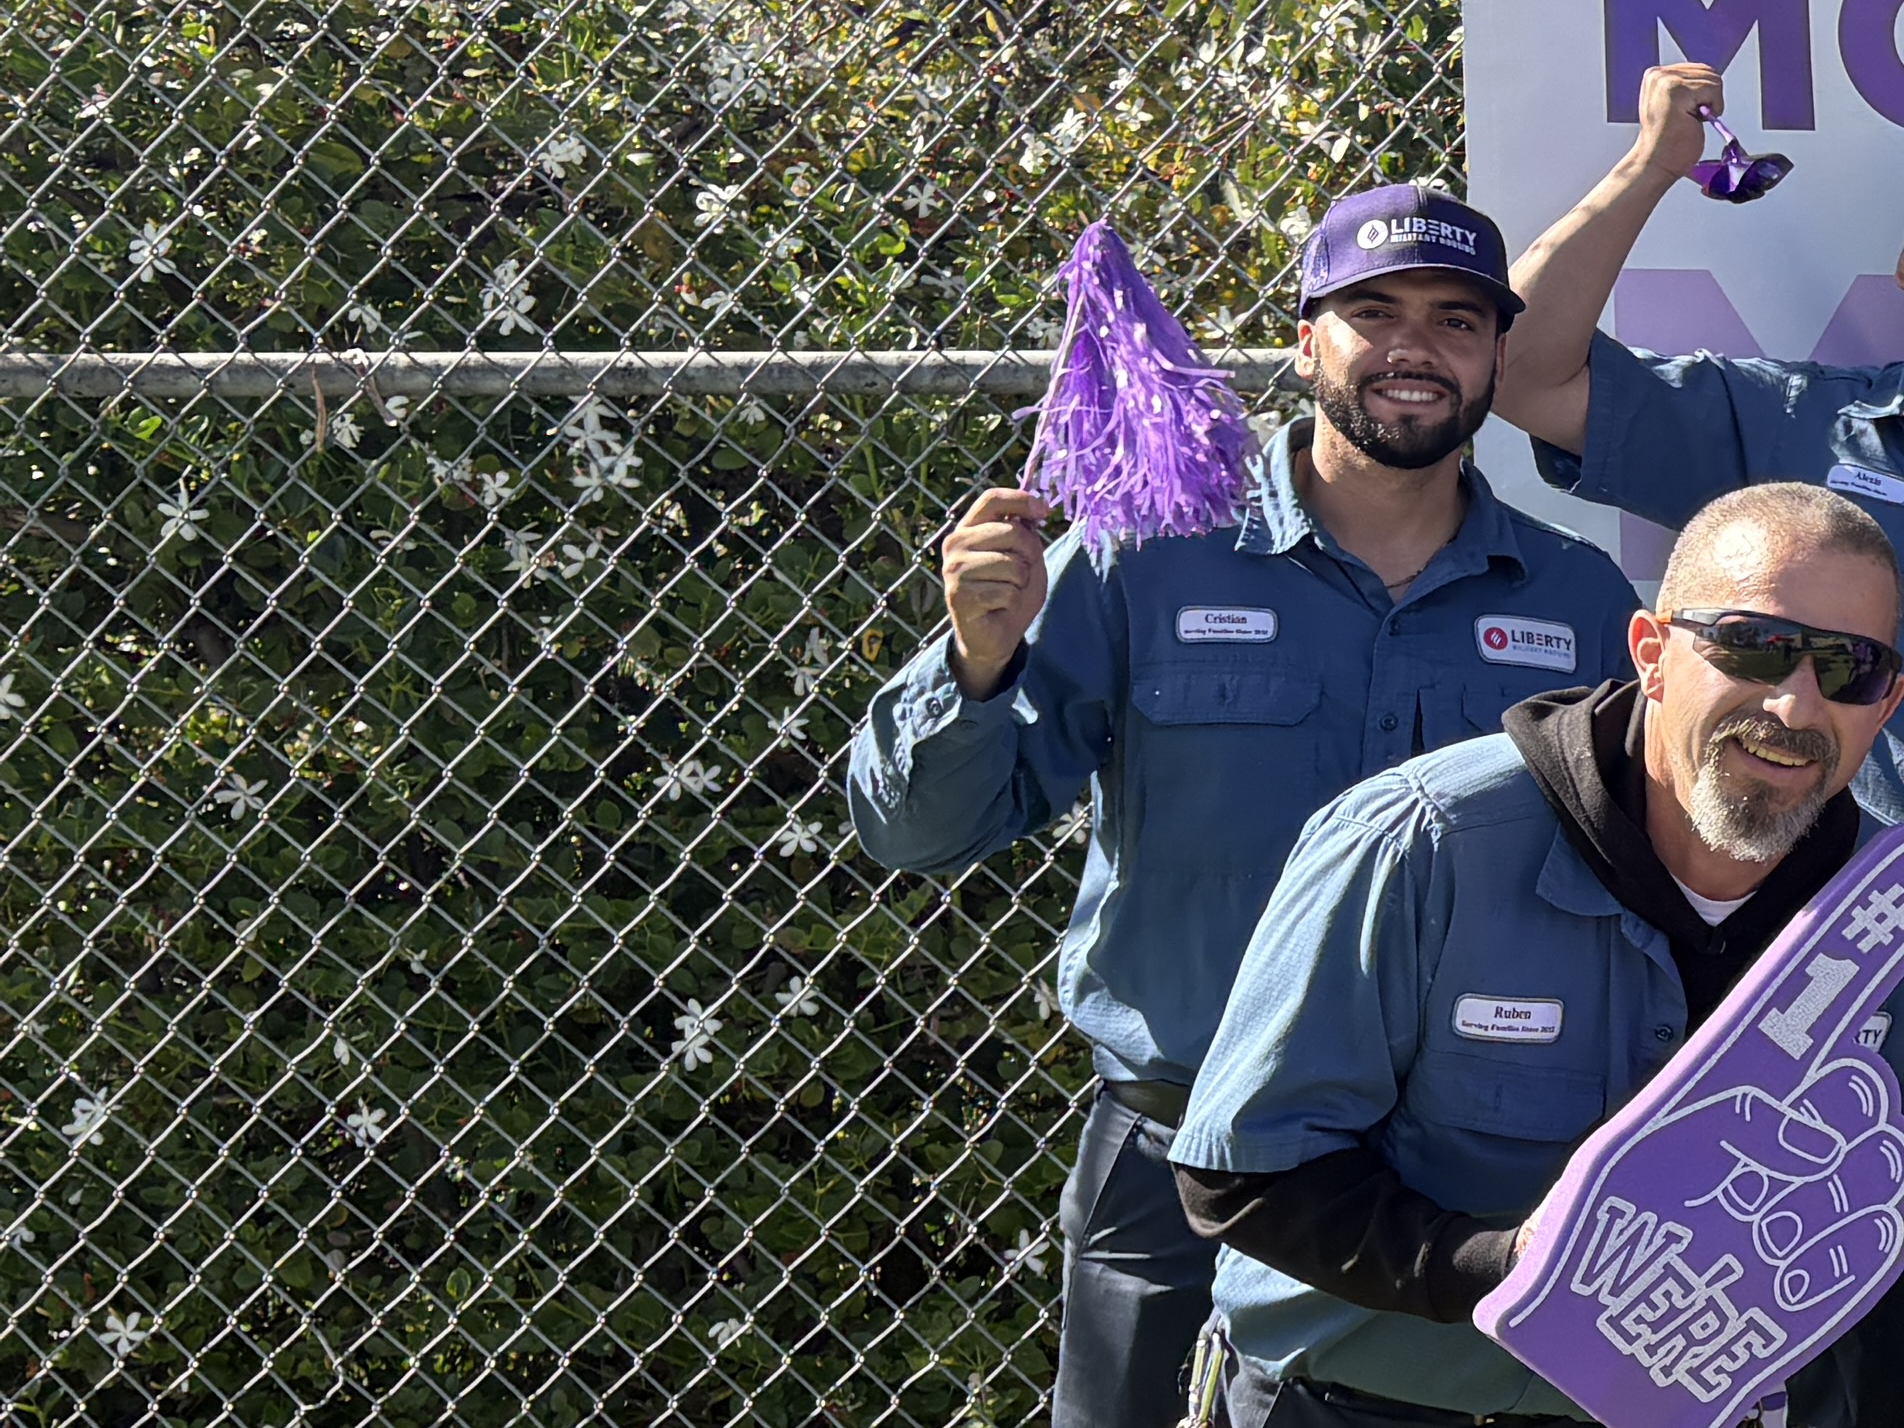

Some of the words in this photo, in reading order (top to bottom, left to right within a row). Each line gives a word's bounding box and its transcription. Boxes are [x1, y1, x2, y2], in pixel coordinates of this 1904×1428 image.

[1390, 217, 1477, 246] LIBERTY
[1204, 613, 1248, 624] Cristian
[1511, 629, 1572, 651] LIBERTY
[1493, 1006, 1531, 1020] Ruben
[1569, 1195, 1787, 1403] WE'RE
